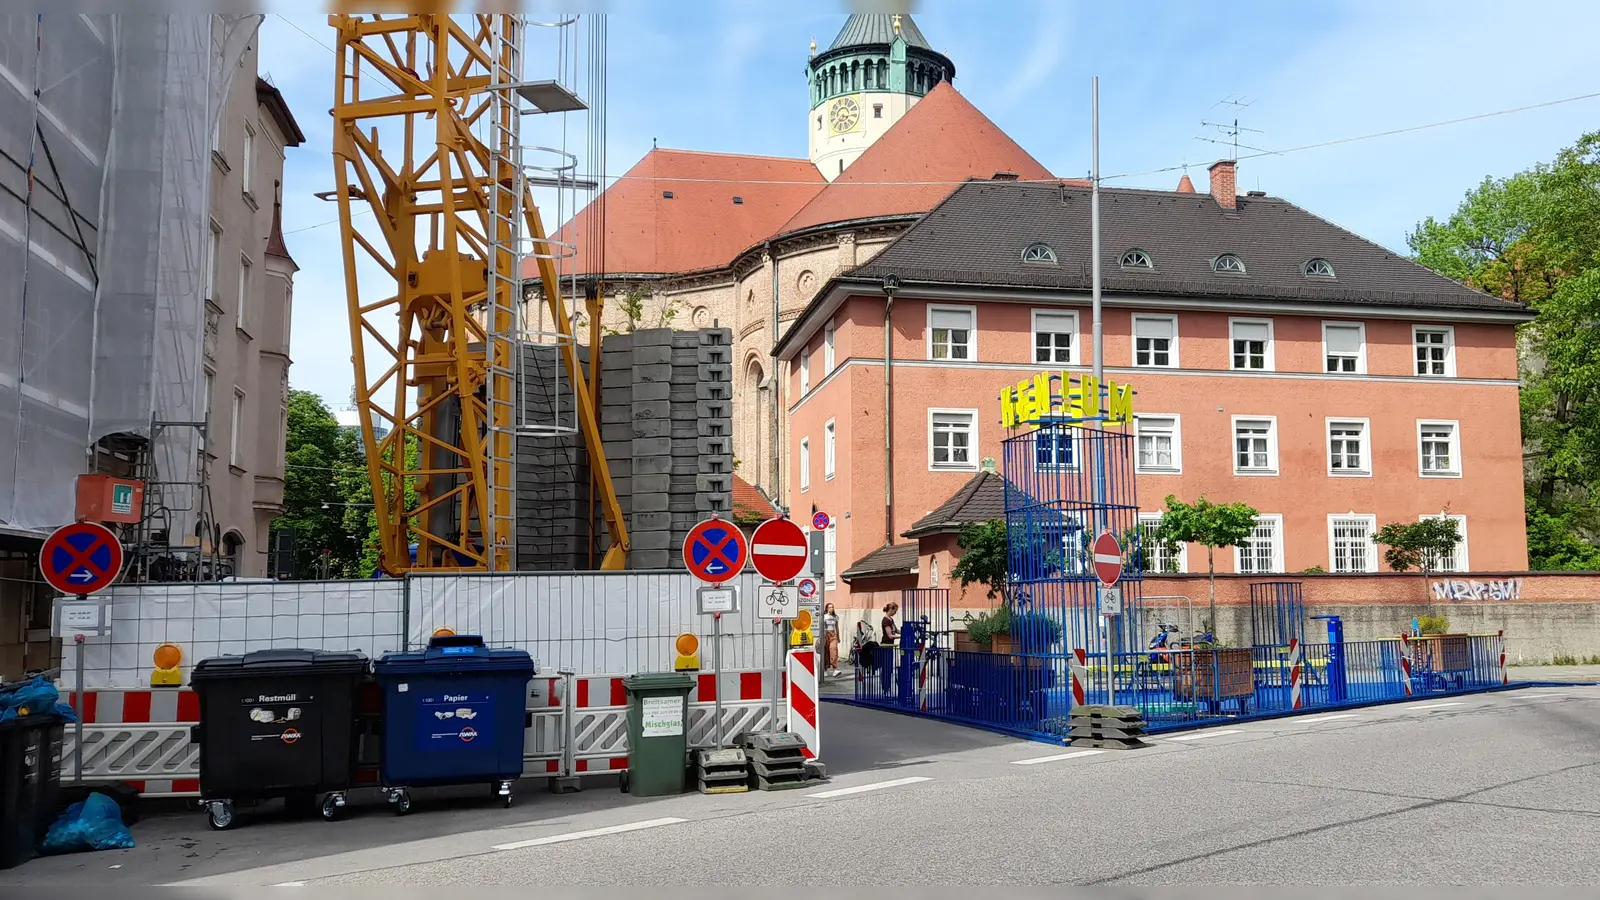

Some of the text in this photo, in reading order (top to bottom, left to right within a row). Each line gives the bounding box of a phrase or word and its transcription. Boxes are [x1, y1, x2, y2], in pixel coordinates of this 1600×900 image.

[770, 607, 783, 615] frei
[258, 693, 296, 703] Restmüll
[443, 694, 468, 703] Papier
